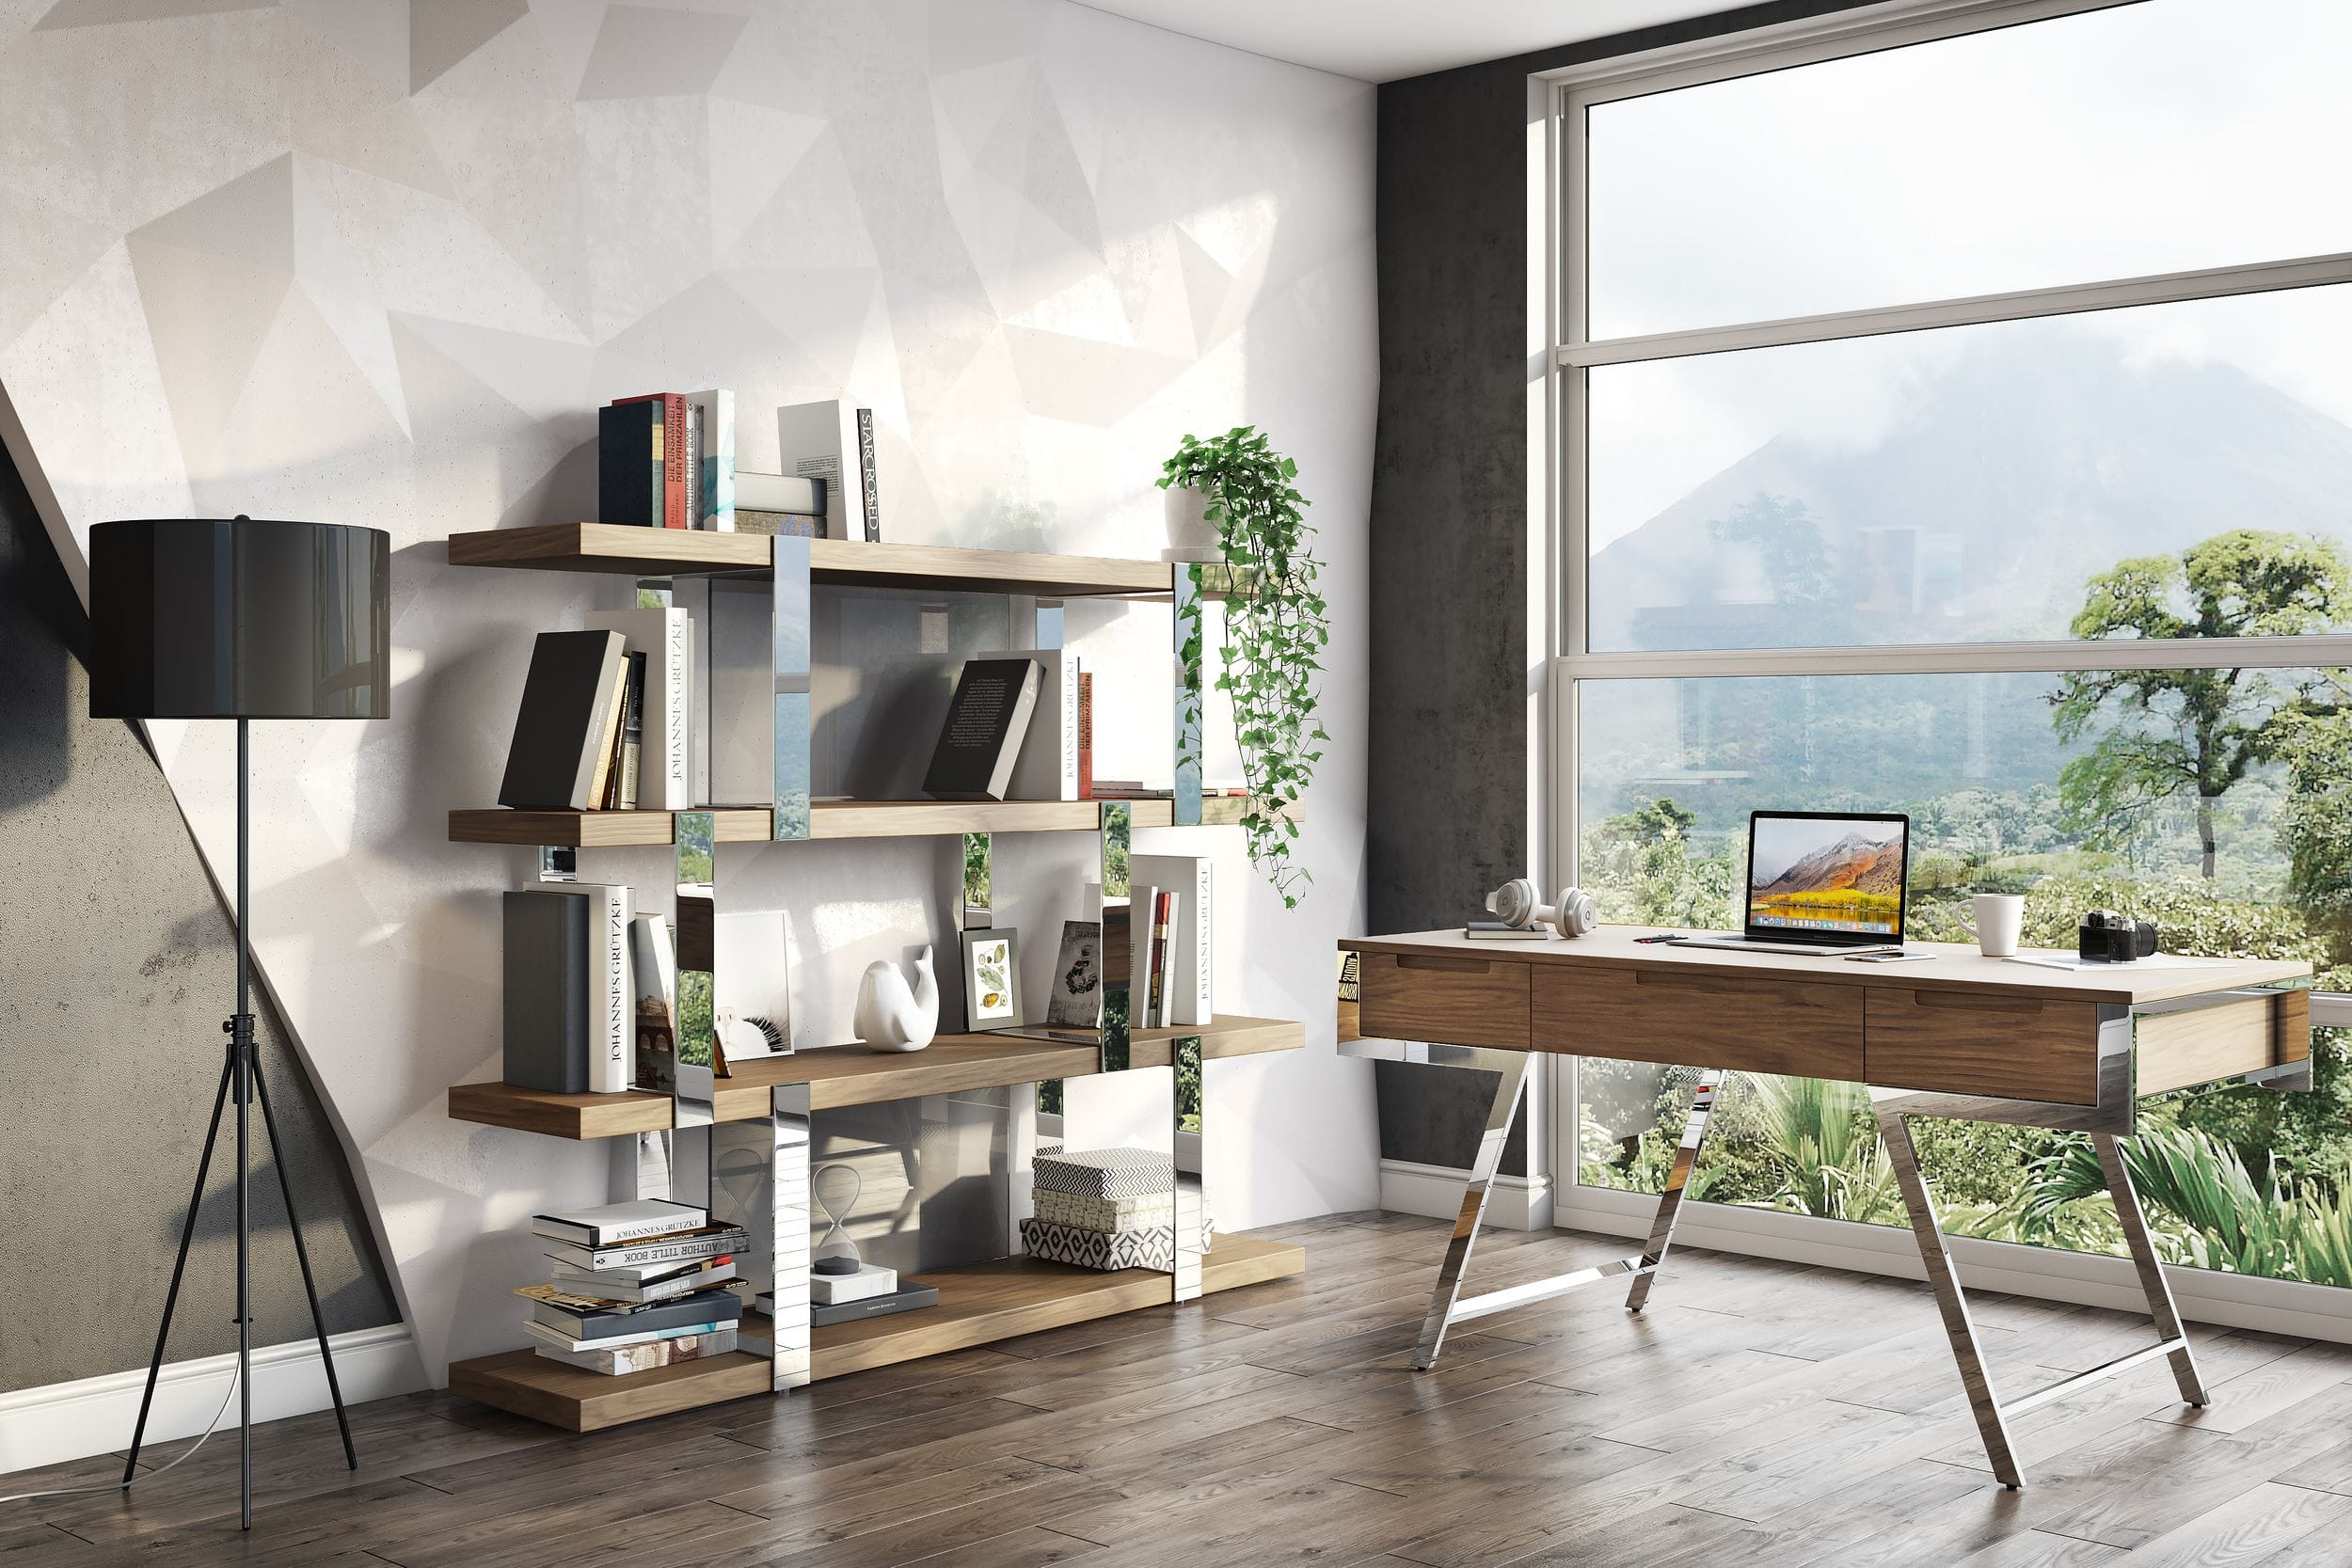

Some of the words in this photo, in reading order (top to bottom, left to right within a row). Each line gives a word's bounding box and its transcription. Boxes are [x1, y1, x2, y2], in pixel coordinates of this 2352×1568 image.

[861, 414, 879, 531] STARCROSSED
[672, 697, 682, 780] JOHANNES
[611, 897, 621, 974] GRÜTZKE
[611, 976, 621, 1062] JOHANNES
[616, 1227, 660, 1240] JOHANNES
[651, 1247, 679, 1259] TITLE
[681, 1243, 718, 1255] AUTHOR
[625, 1251, 648, 1262] BOOK
